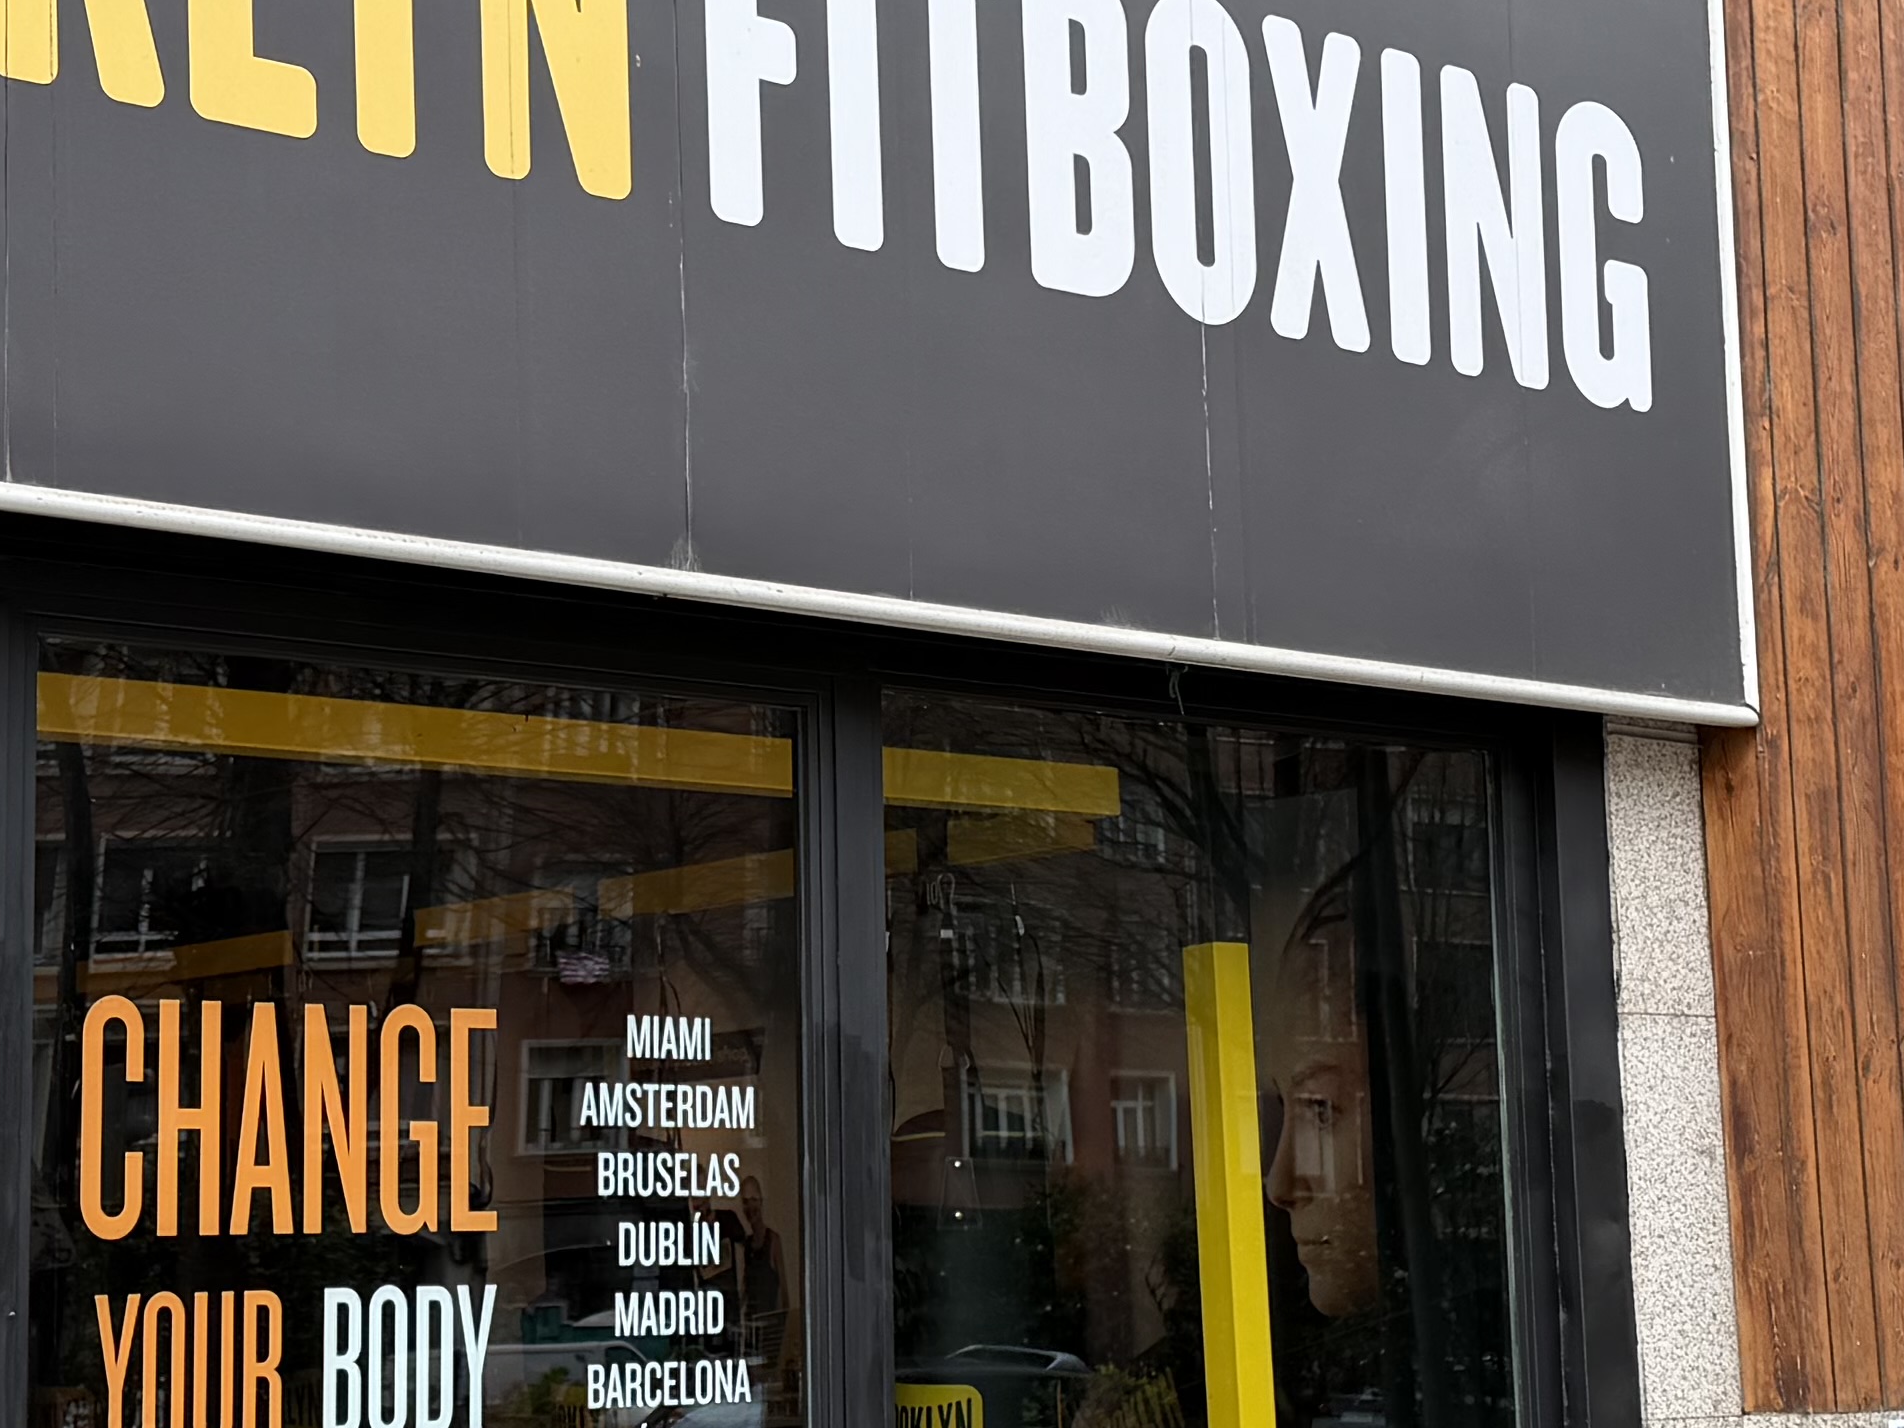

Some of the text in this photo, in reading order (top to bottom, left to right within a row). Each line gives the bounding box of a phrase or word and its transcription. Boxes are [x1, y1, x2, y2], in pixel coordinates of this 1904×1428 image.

[626, 1014, 711, 1061] MIAMI
[81, 995, 498, 1240] CHANGE
[579, 1081, 755, 1130] AMSTERDAM
[597, 1151, 740, 1198] BRUSELAS
[618, 1210, 720, 1267] DUBLÍN
[614, 1289, 724, 1338] MADRID
[587, 1358, 752, 1410] BARCELONA
